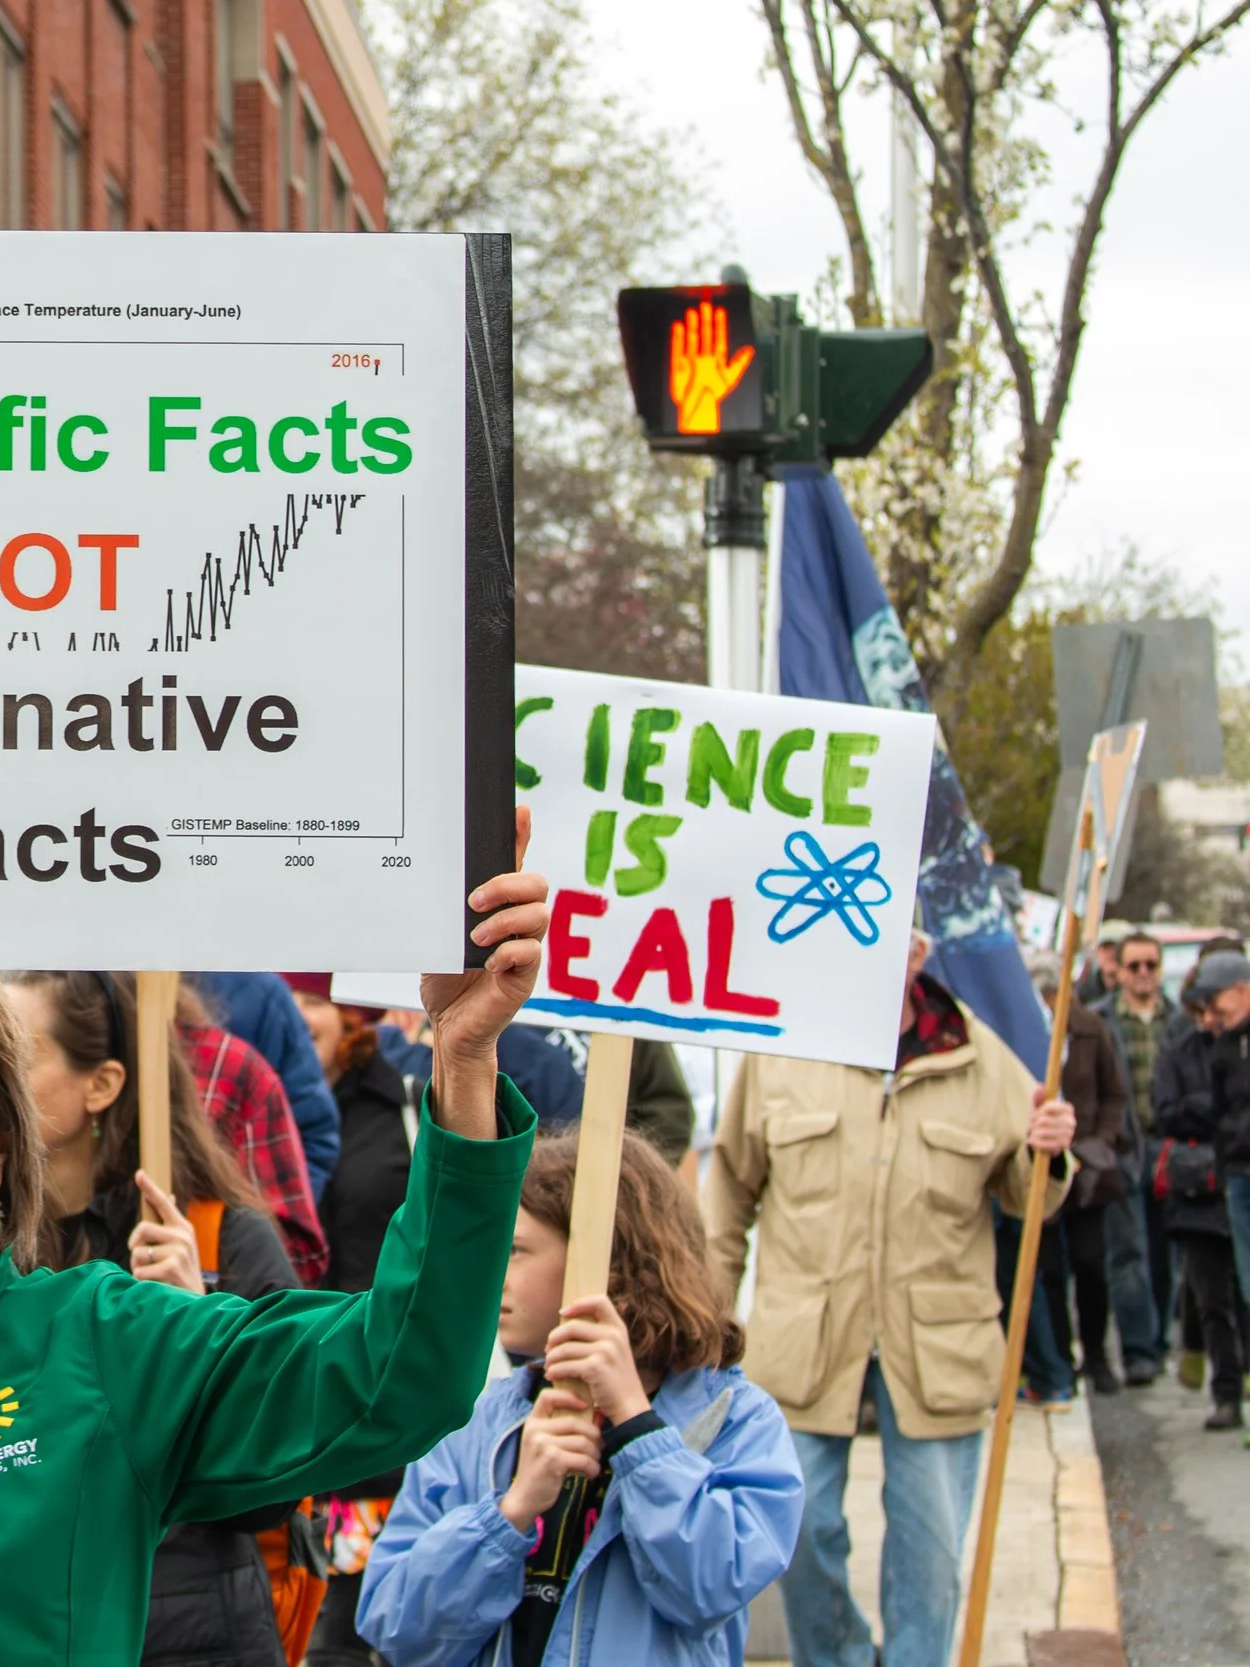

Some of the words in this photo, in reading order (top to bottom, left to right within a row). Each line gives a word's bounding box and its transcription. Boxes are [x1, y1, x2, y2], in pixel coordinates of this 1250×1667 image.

[24, 303, 121, 321] Temperature
[126, 303, 242, 321] (January-June)
[331, 353, 371, 368] 2016
[148, 396, 413, 474] Facts
[515, 696, 880, 827] CIENCE
[171, 818, 232, 831] GISTEMP
[236, 819, 291, 831] Baseline:
[296, 819, 360, 832] 1880-1899
[188, 854, 218, 866] 1980
[284, 855, 315, 867] 2000
[584, 810, 683, 897] IS
[381, 856, 412, 868] 2020
[547, 888, 781, 1018] EAL
[12, 1454, 42, 1469] INC.
